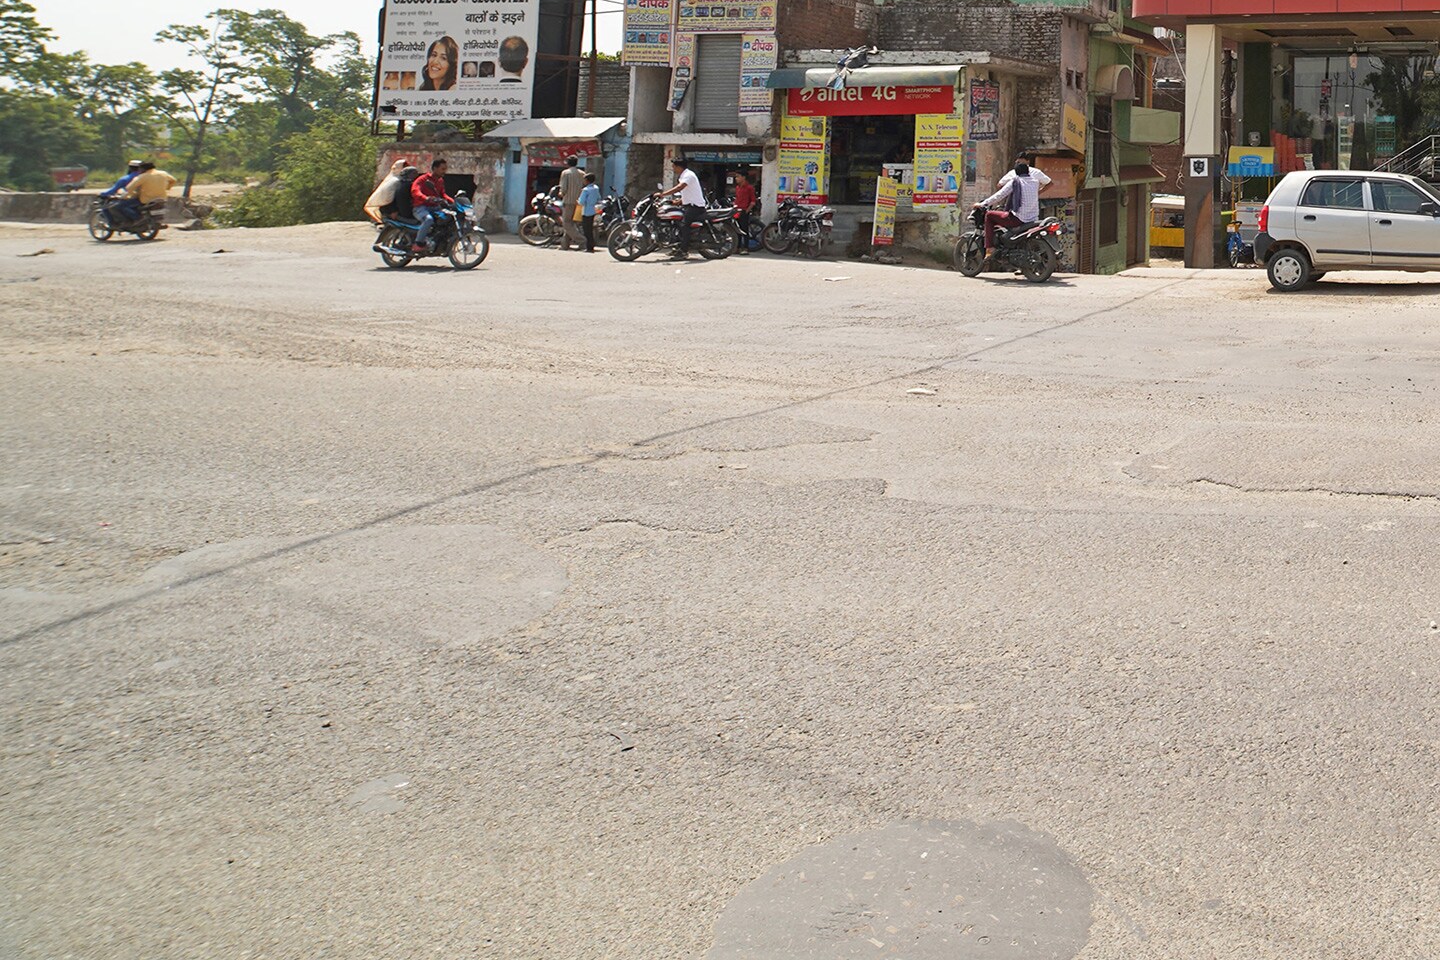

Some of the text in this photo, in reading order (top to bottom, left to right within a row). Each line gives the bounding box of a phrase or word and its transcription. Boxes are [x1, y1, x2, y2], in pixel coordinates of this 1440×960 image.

[465, 10, 488, 23] बालों
[489, 10, 499, 22] के
[817, 86, 896, 101] airtel 4G
